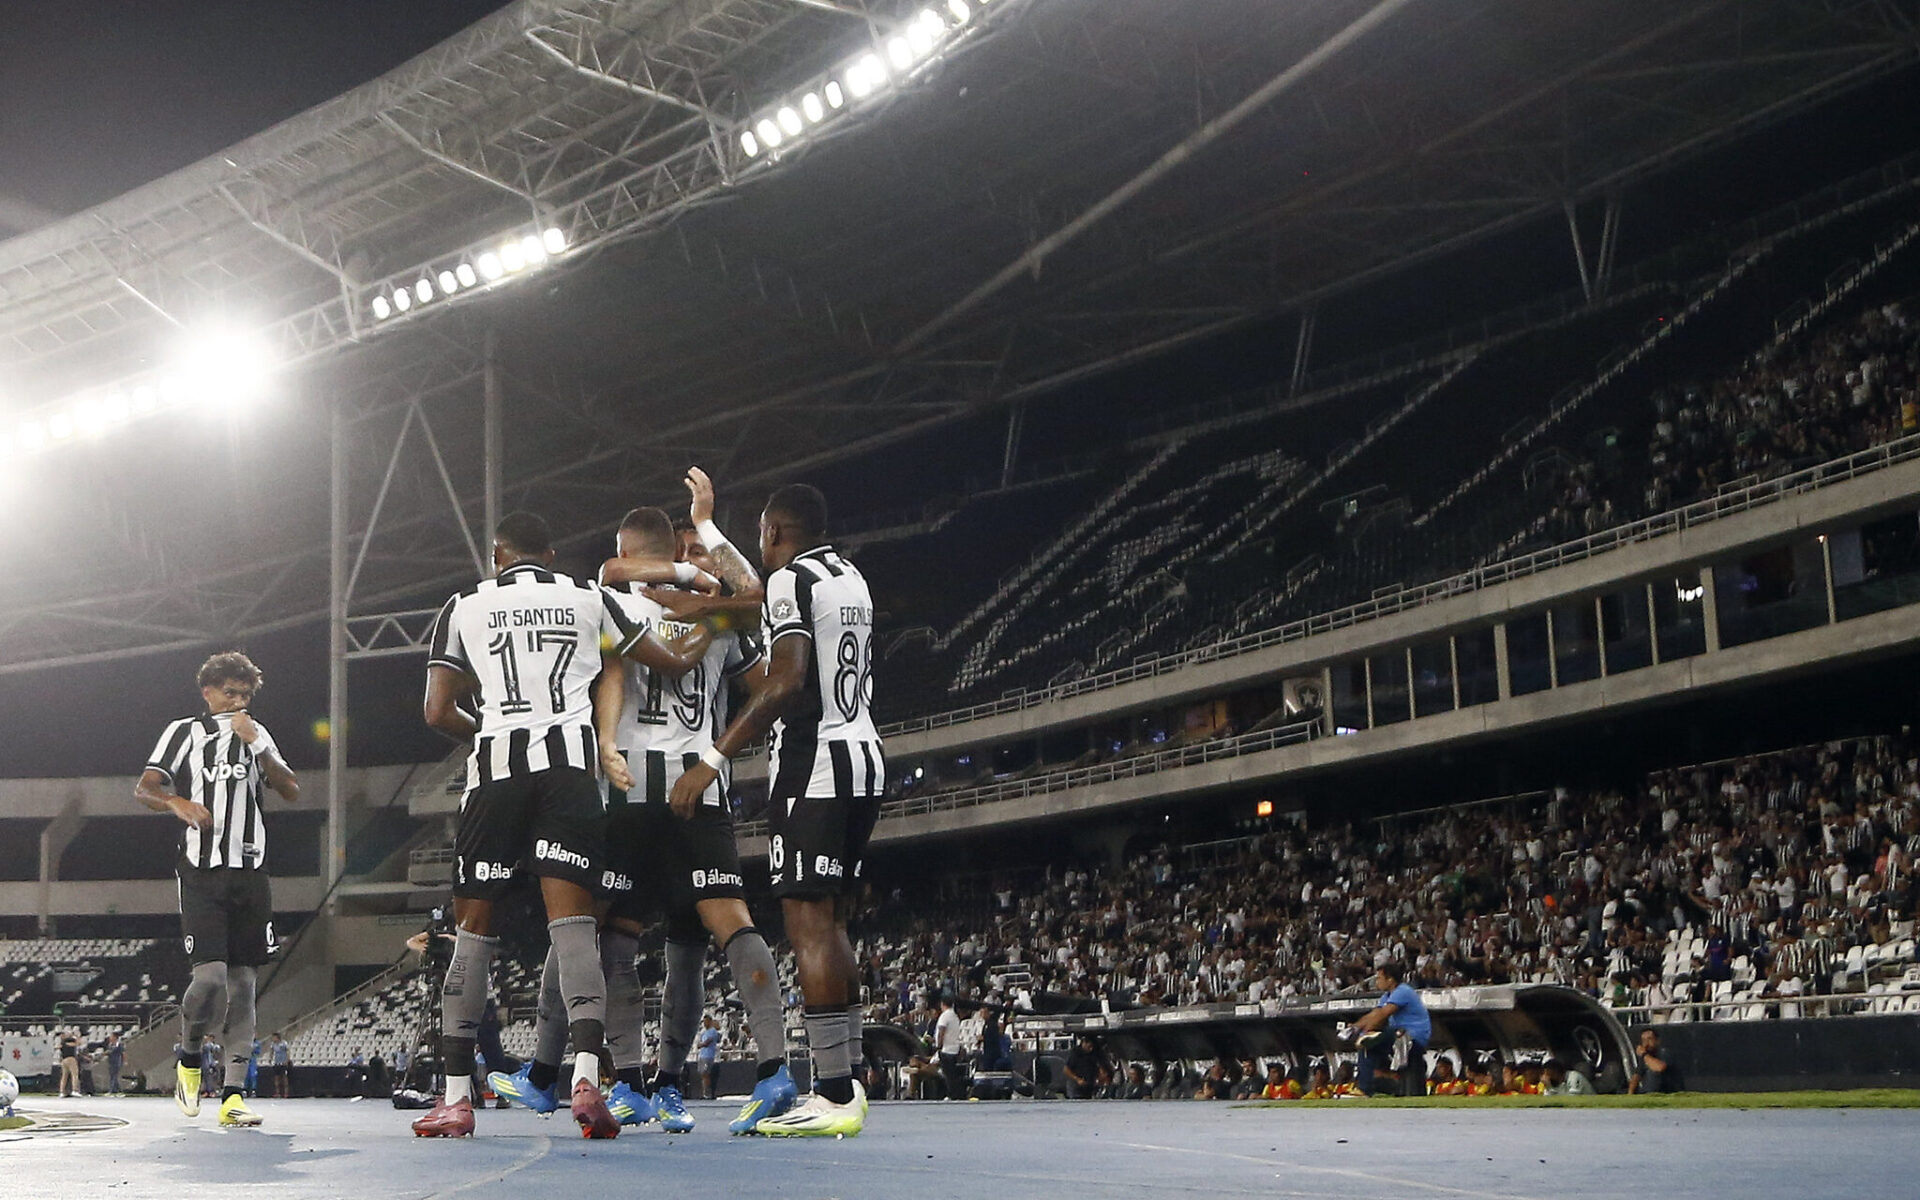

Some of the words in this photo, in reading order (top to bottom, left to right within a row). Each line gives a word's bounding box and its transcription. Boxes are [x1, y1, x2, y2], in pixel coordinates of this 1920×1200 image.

[488, 611, 507, 629] JR
[512, 607, 575, 627] SANTOS
[488, 630, 578, 716] 17
[637, 660, 706, 732] 19
[202, 760, 248, 782] vbe
[547, 842, 590, 869] álamo
[769, 834, 785, 872] 8
[490, 862, 514, 879] ála
[707, 868, 743, 887] álamo
[266, 921, 275, 946] 6
